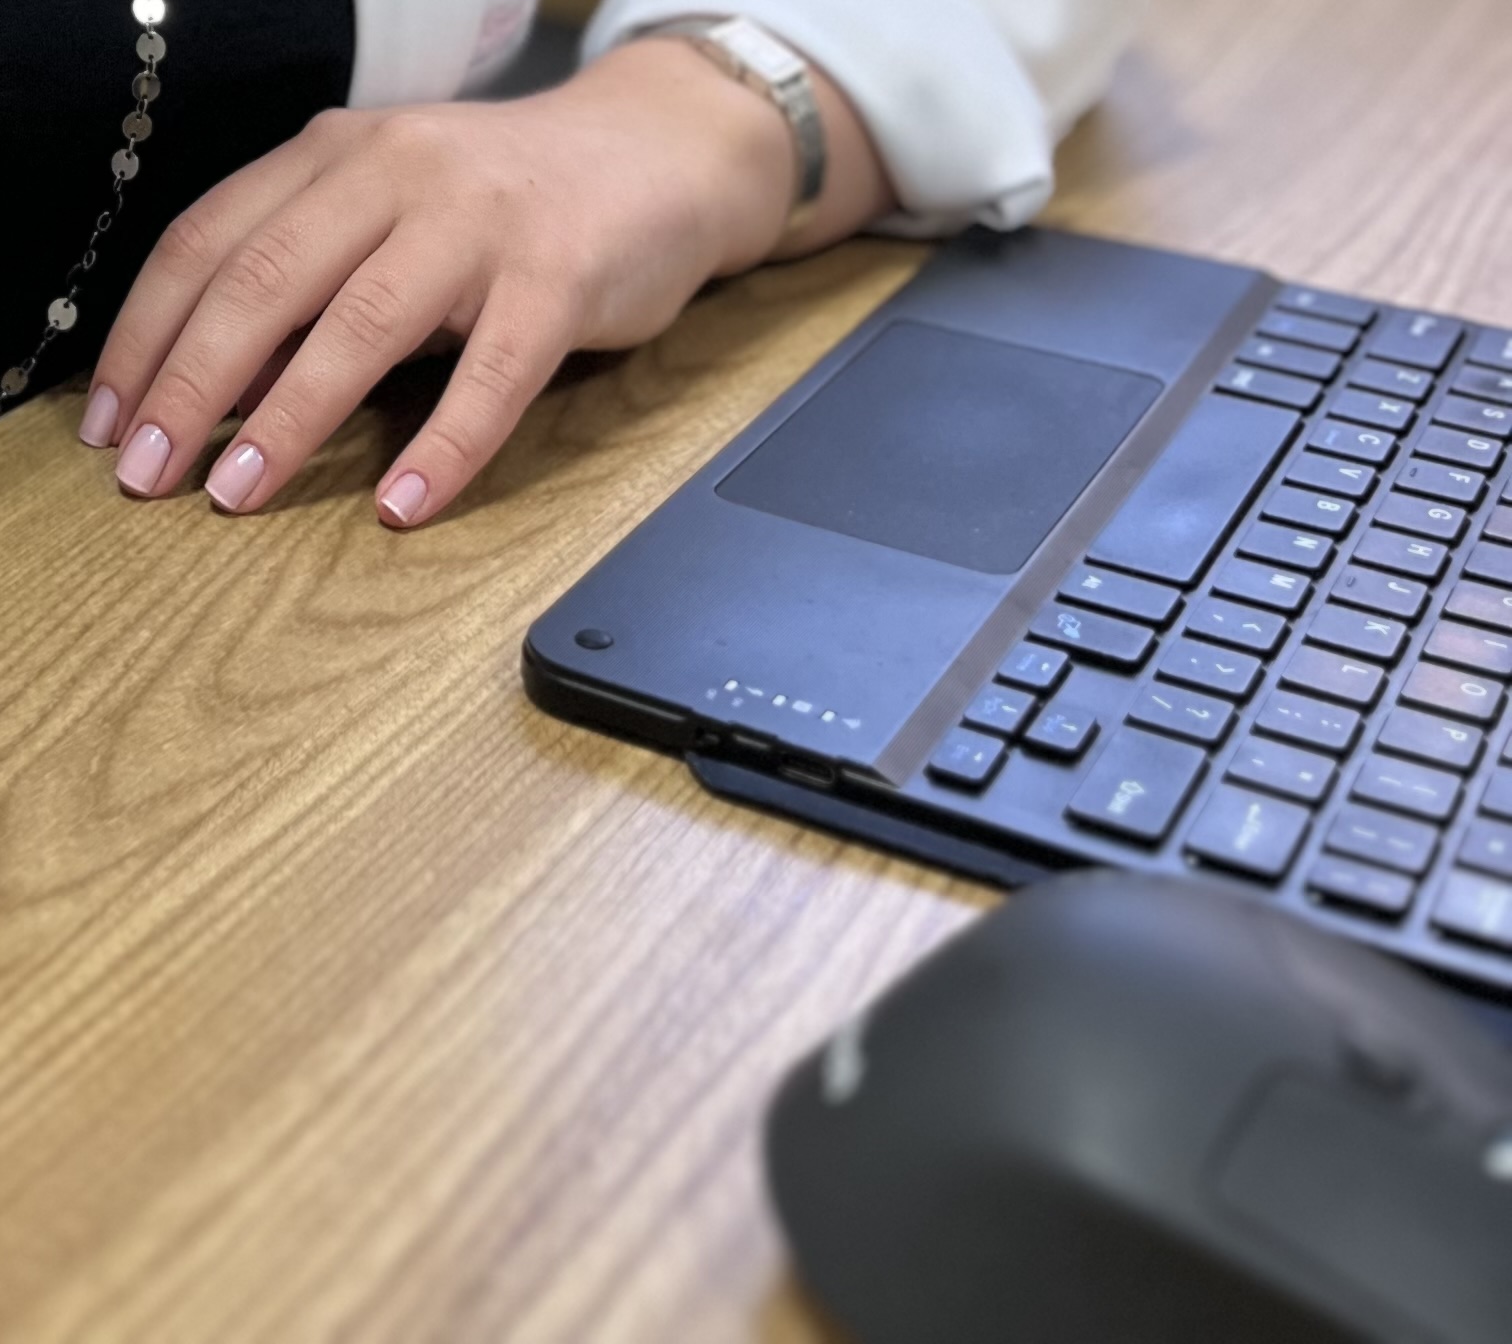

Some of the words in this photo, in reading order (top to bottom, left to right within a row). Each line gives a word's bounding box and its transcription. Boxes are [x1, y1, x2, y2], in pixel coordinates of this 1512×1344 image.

[1482, 408, 1506, 419] S
[1358, 433, 1381, 445] C
[1338, 468, 1362, 479] V
[1448, 472, 1471, 484] F
[1316, 500, 1341, 512] B
[1427, 508, 1453, 520] G
[1293, 536, 1319, 549] N
[1407, 543, 1433, 557] H
[1269, 573, 1296, 589] M
[1387, 581, 1411, 594] J
[1364, 620, 1391, 635] K
[1442, 727, 1468, 742] P
